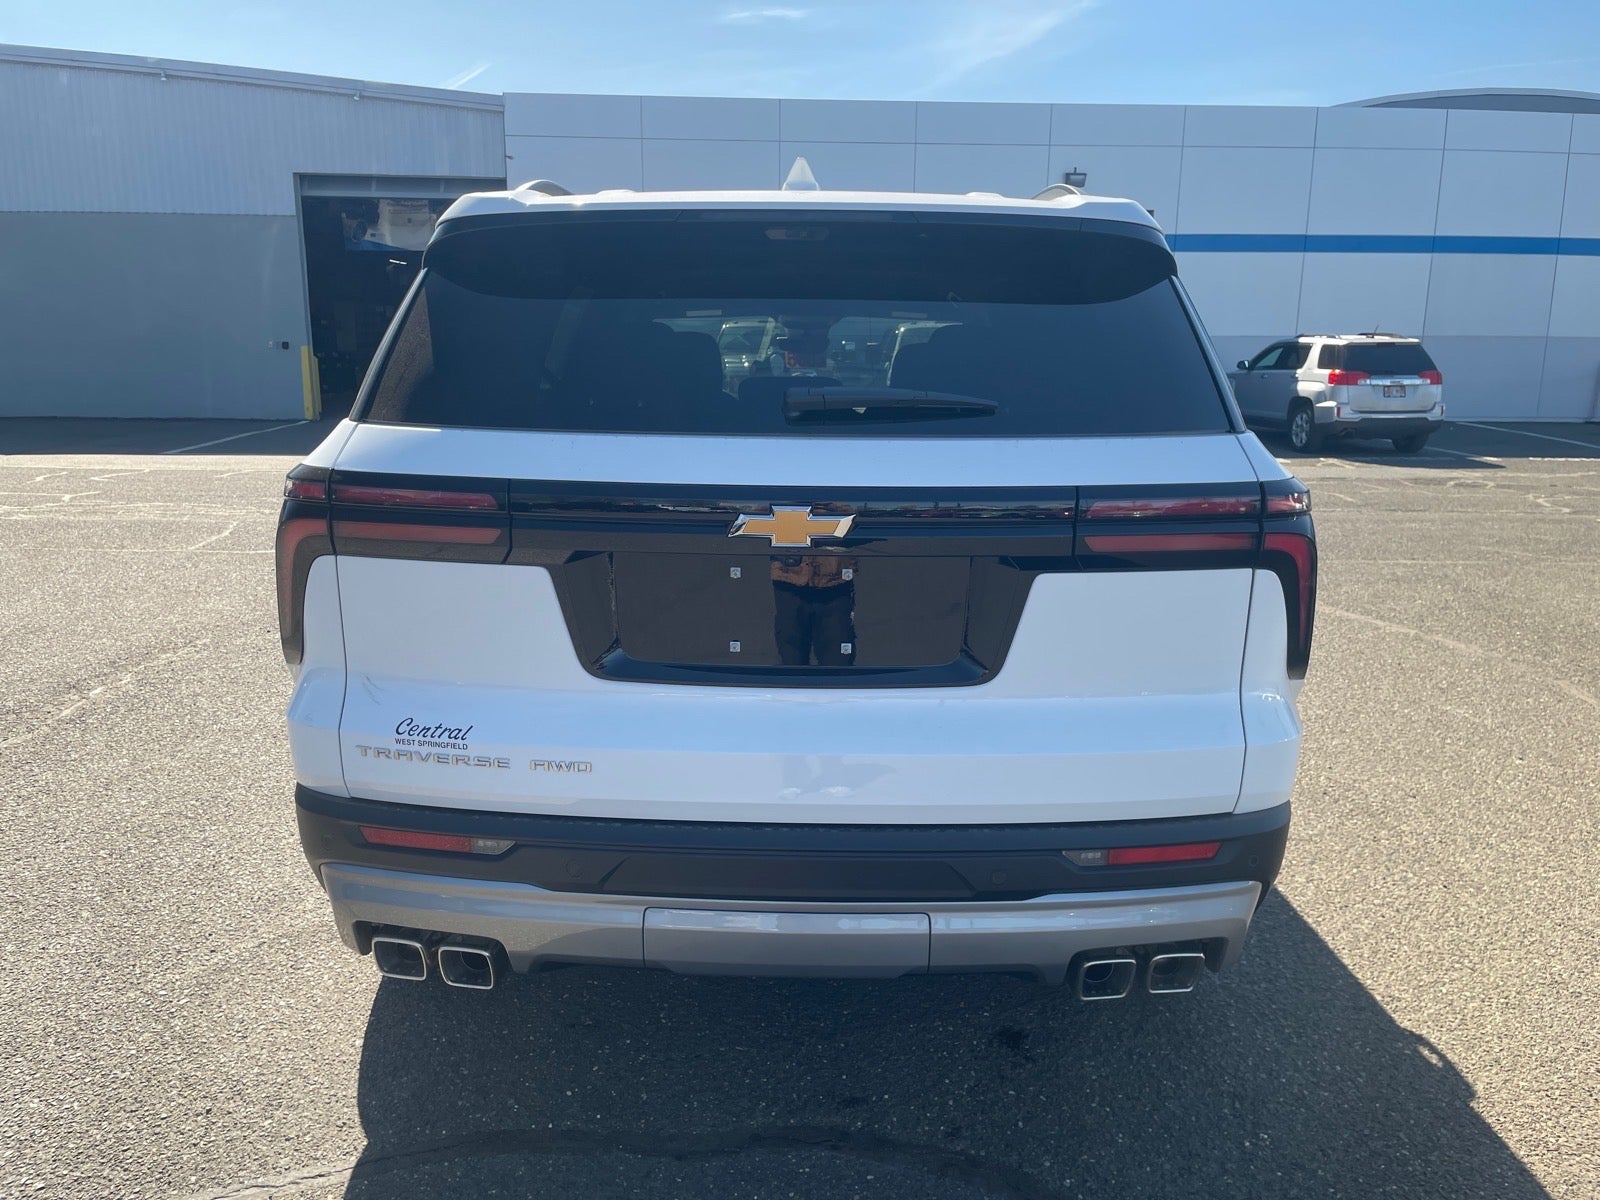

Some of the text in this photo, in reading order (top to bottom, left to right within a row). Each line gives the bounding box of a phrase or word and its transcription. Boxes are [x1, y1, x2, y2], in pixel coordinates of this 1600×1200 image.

[395, 717, 474, 741] Central
[395, 738, 468, 750] WEST SPRINGFIELD
[356, 745, 592, 773] TRAVERSE AWD
